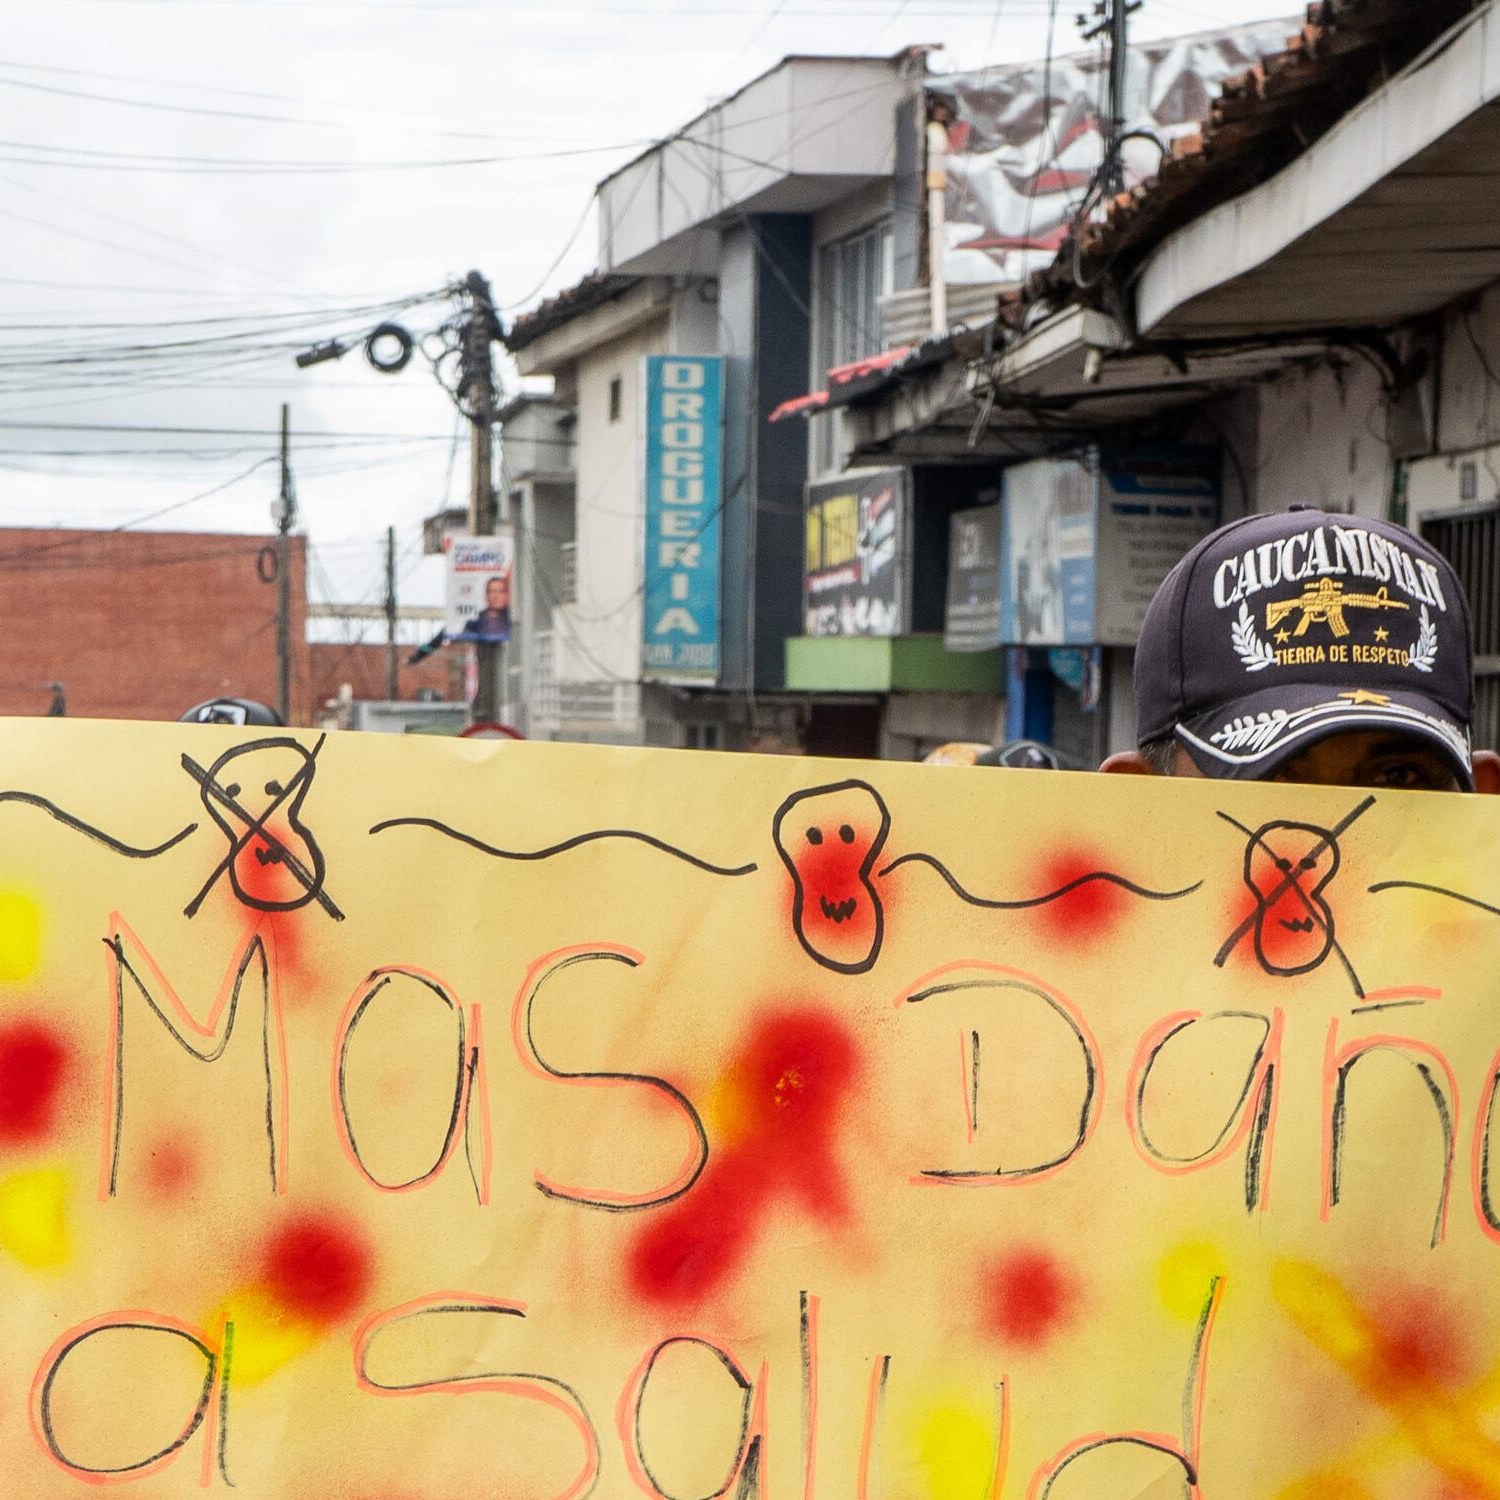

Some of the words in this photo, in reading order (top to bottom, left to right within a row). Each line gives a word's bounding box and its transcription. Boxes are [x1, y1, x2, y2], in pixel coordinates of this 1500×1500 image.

[654, 361, 704, 637] DROGUERIA
[1213, 525, 1446, 612] CAUCANISTAN
[1275, 647, 1325, 668] TIERRA
[1329, 646, 1349, 664] DE
[1353, 645, 1410, 668] RESPETO
